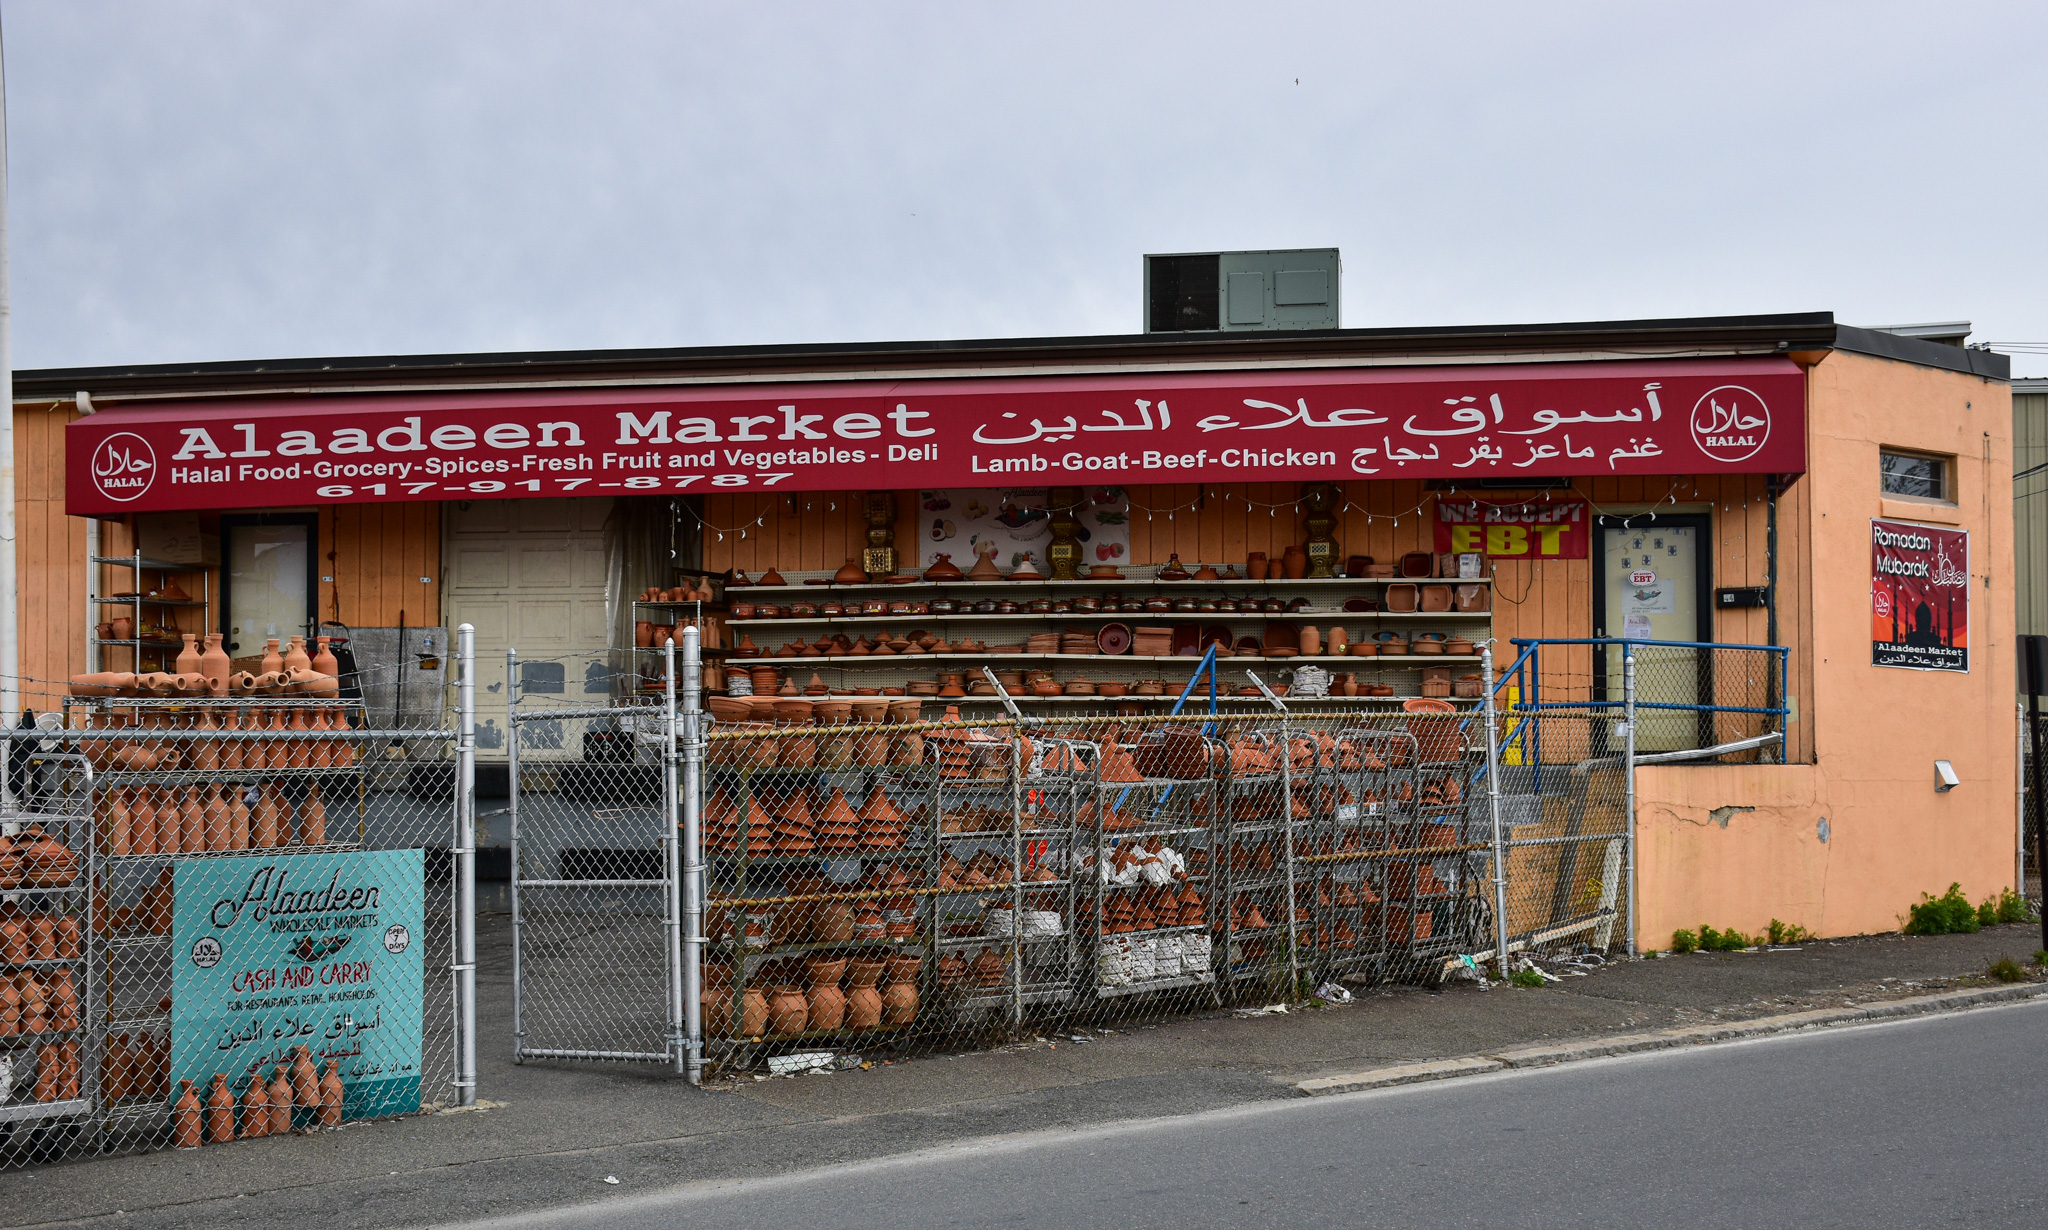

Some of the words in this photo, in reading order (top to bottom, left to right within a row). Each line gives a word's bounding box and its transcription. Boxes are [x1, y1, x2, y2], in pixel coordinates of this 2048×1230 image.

[973, 399, 1170, 444] الدين
[1197, 398, 1388, 432] علاء
[1403, 383, 1661, 435] أسواق
[1696, 398, 1766, 434] حلال
[172, 417, 585, 460] Alaadeen
[615, 404, 935, 444] Market
[1706, 436, 1757, 447] HALAL
[96, 444, 152, 476] حلال
[172, 466, 230, 483] Halal
[603, 452, 661, 469] Fruit
[669, 450, 715, 467] and
[889, 444, 937, 461] Deli
[1352, 436, 1438, 473] دجاج
[1452, 436, 1503, 467] بقر
[1513, 434, 1594, 467] ماعز
[1609, 438, 1662, 470] غنم
[104, 478, 144, 487] HALAL
[317, 473, 793, 497] 617-917-8787
[1439, 504, 1479, 522] WE
[1485, 503, 1584, 522] ACCEPT
[1452, 525, 1570, 555] EBT
[1874, 526, 1931, 551] Ramadan
[1877, 554, 1930, 577] Mubarak
[1878, 643, 1926, 654] Alaadeen
[1928, 646, 1963, 656] Market
[1880, 654, 1905, 664] الدين
[1908, 655, 1931, 665] علاء
[1932, 657, 1963, 667] أسواق
[211, 866, 380, 929] Alaadeen
[270, 917, 333, 934] WHOLESALE
[334, 914, 378, 932] MARKETS
[233, 970, 276, 993] CASH
[282, 966, 314, 990] AND
[320, 960, 373, 985] CARRY
[228, 1000, 243, 1011] FOR
